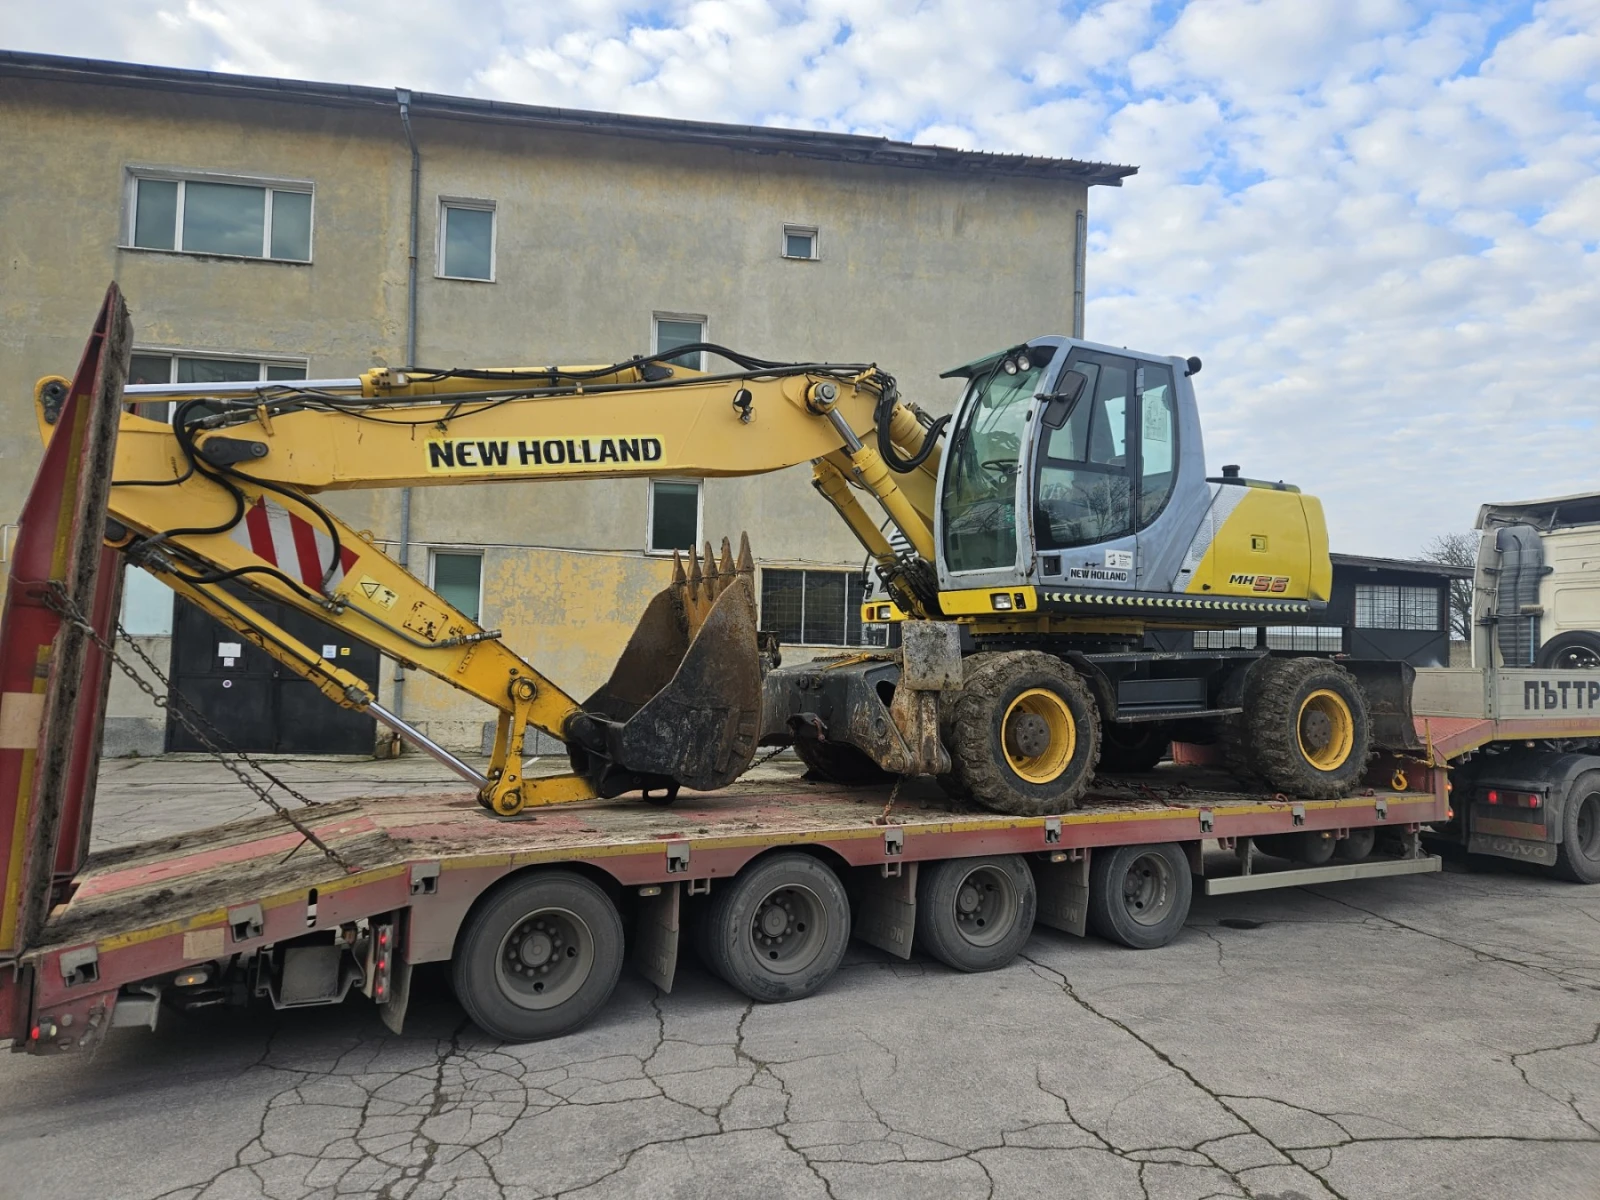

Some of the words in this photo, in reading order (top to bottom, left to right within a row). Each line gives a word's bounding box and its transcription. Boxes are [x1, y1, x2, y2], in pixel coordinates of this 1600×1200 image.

[428, 440, 509, 468] NEW
[517, 438, 662, 465] HOLLAND
[1070, 568, 1090, 579] NEW
[1090, 570, 1127, 581] HOLLAND
[1524, 680, 1600, 710] ПЪТТР
